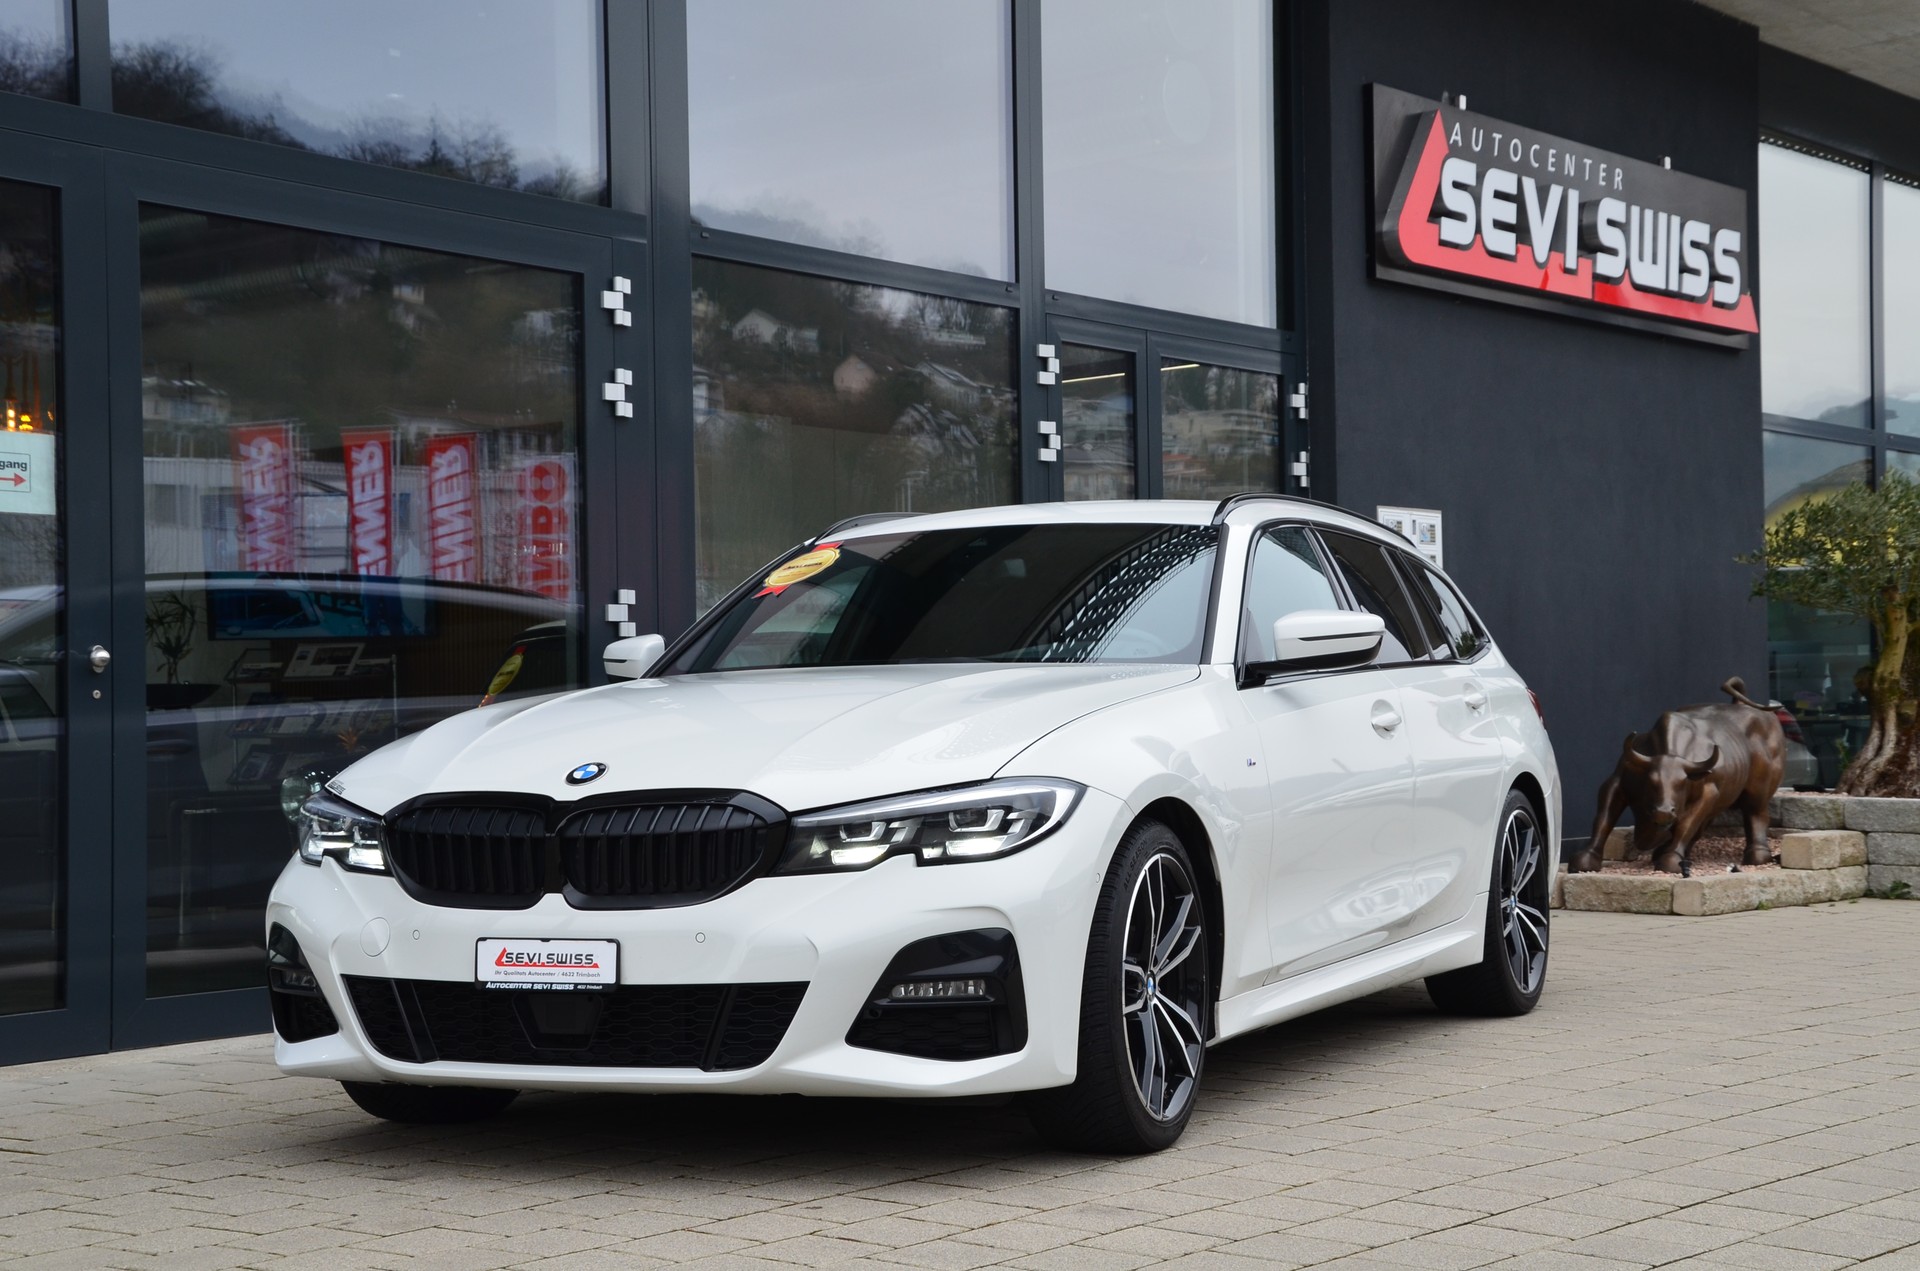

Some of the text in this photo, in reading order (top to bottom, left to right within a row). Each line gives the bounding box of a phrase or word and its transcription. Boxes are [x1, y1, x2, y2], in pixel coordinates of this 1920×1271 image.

[1449, 121, 1624, 191] AUTOCENTER
[1438, 157, 1742, 305] SEVI SWISS
[504, 952, 594, 965] SEVI SWISS
[552, 983, 575, 991] SWISS
